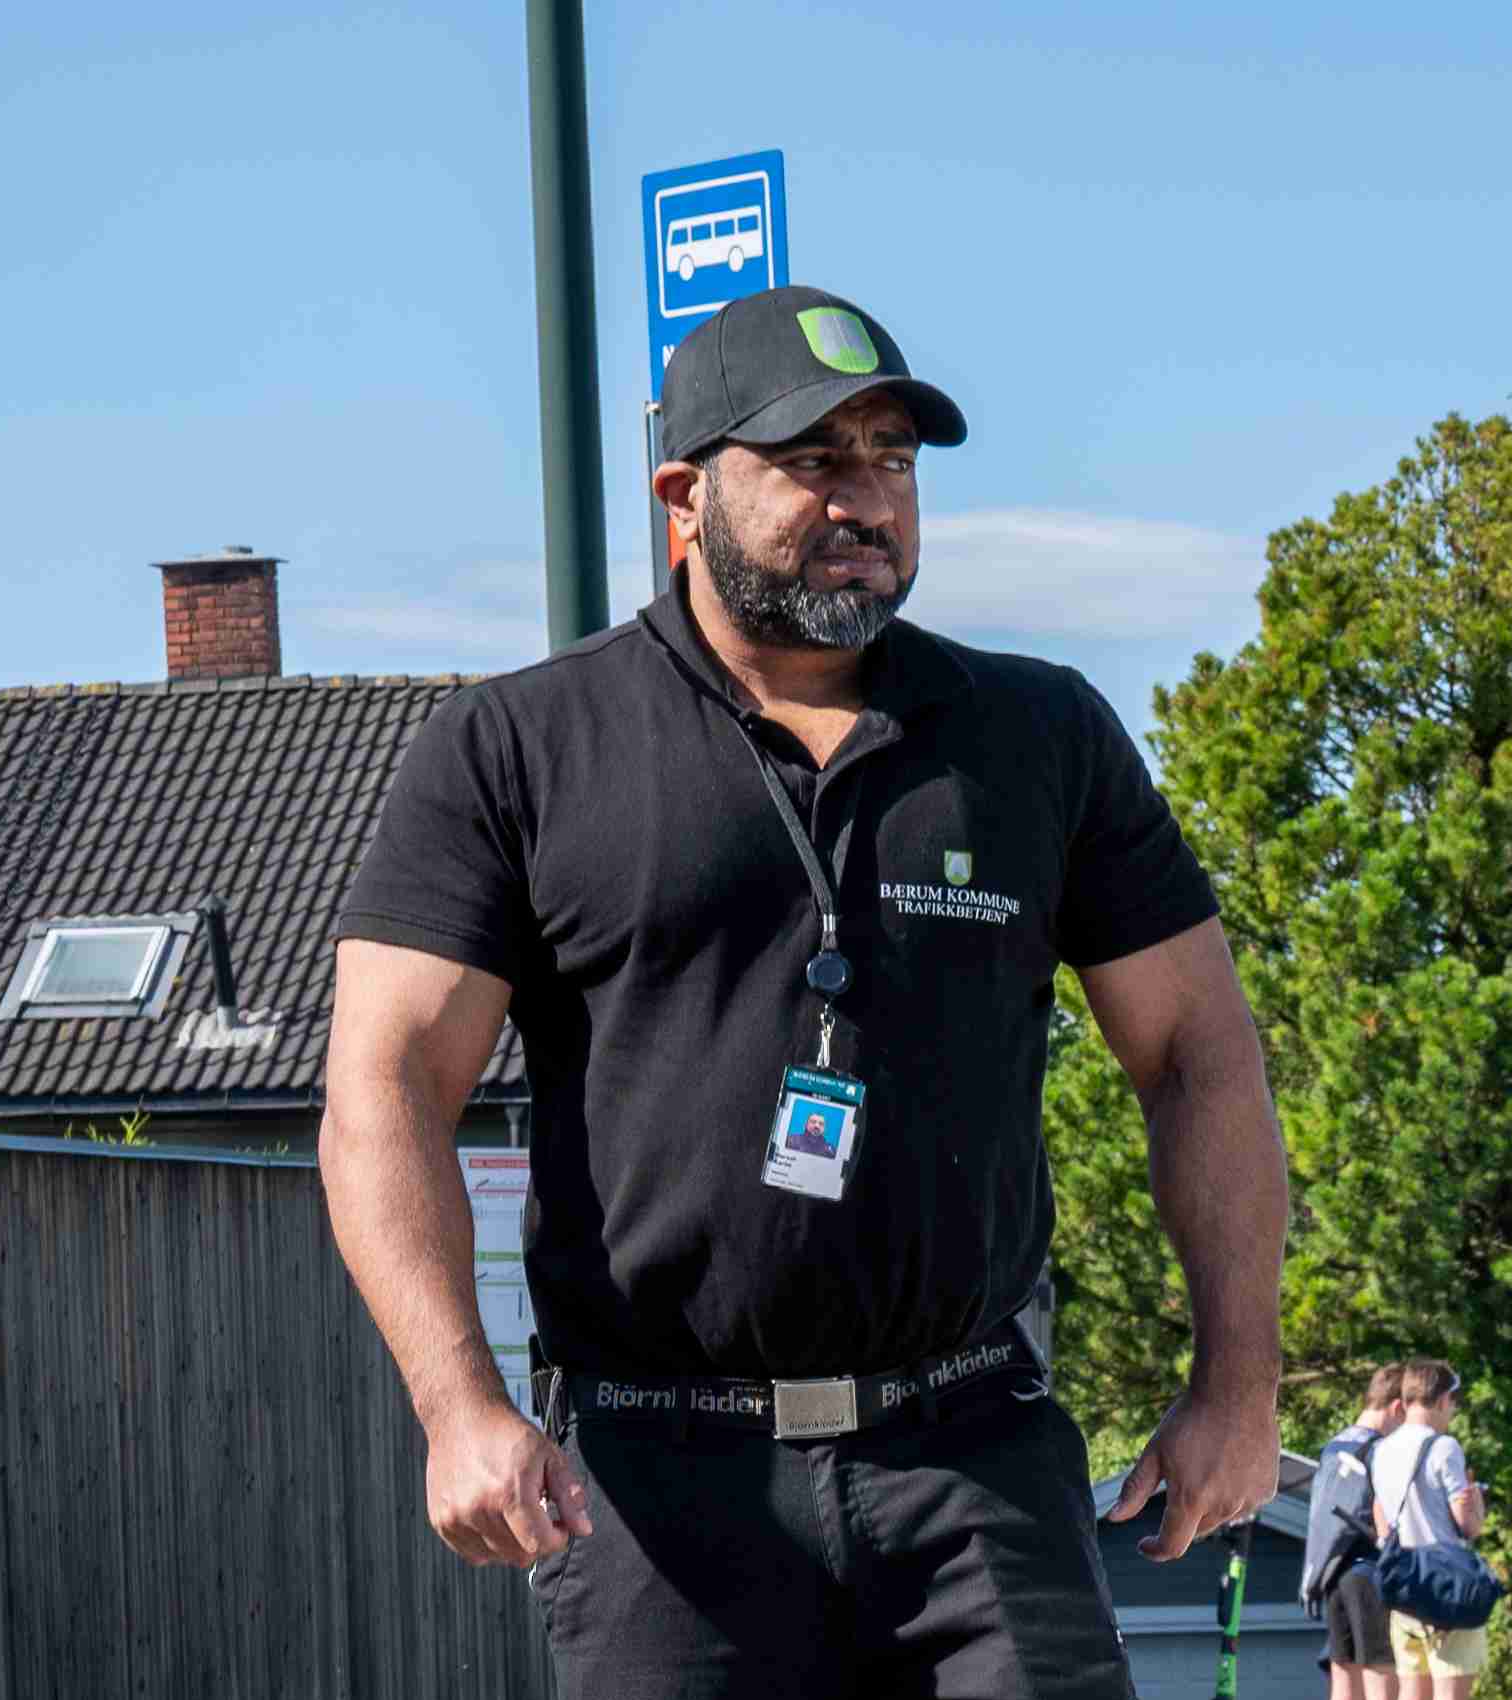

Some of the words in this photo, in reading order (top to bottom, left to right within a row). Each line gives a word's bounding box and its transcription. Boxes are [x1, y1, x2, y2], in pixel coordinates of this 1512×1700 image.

[879, 882, 943, 902] BÆRUM
[947, 887, 1021, 915] KOMMUNE
[895, 900, 1009, 926] TRAFIKKBETJENT
